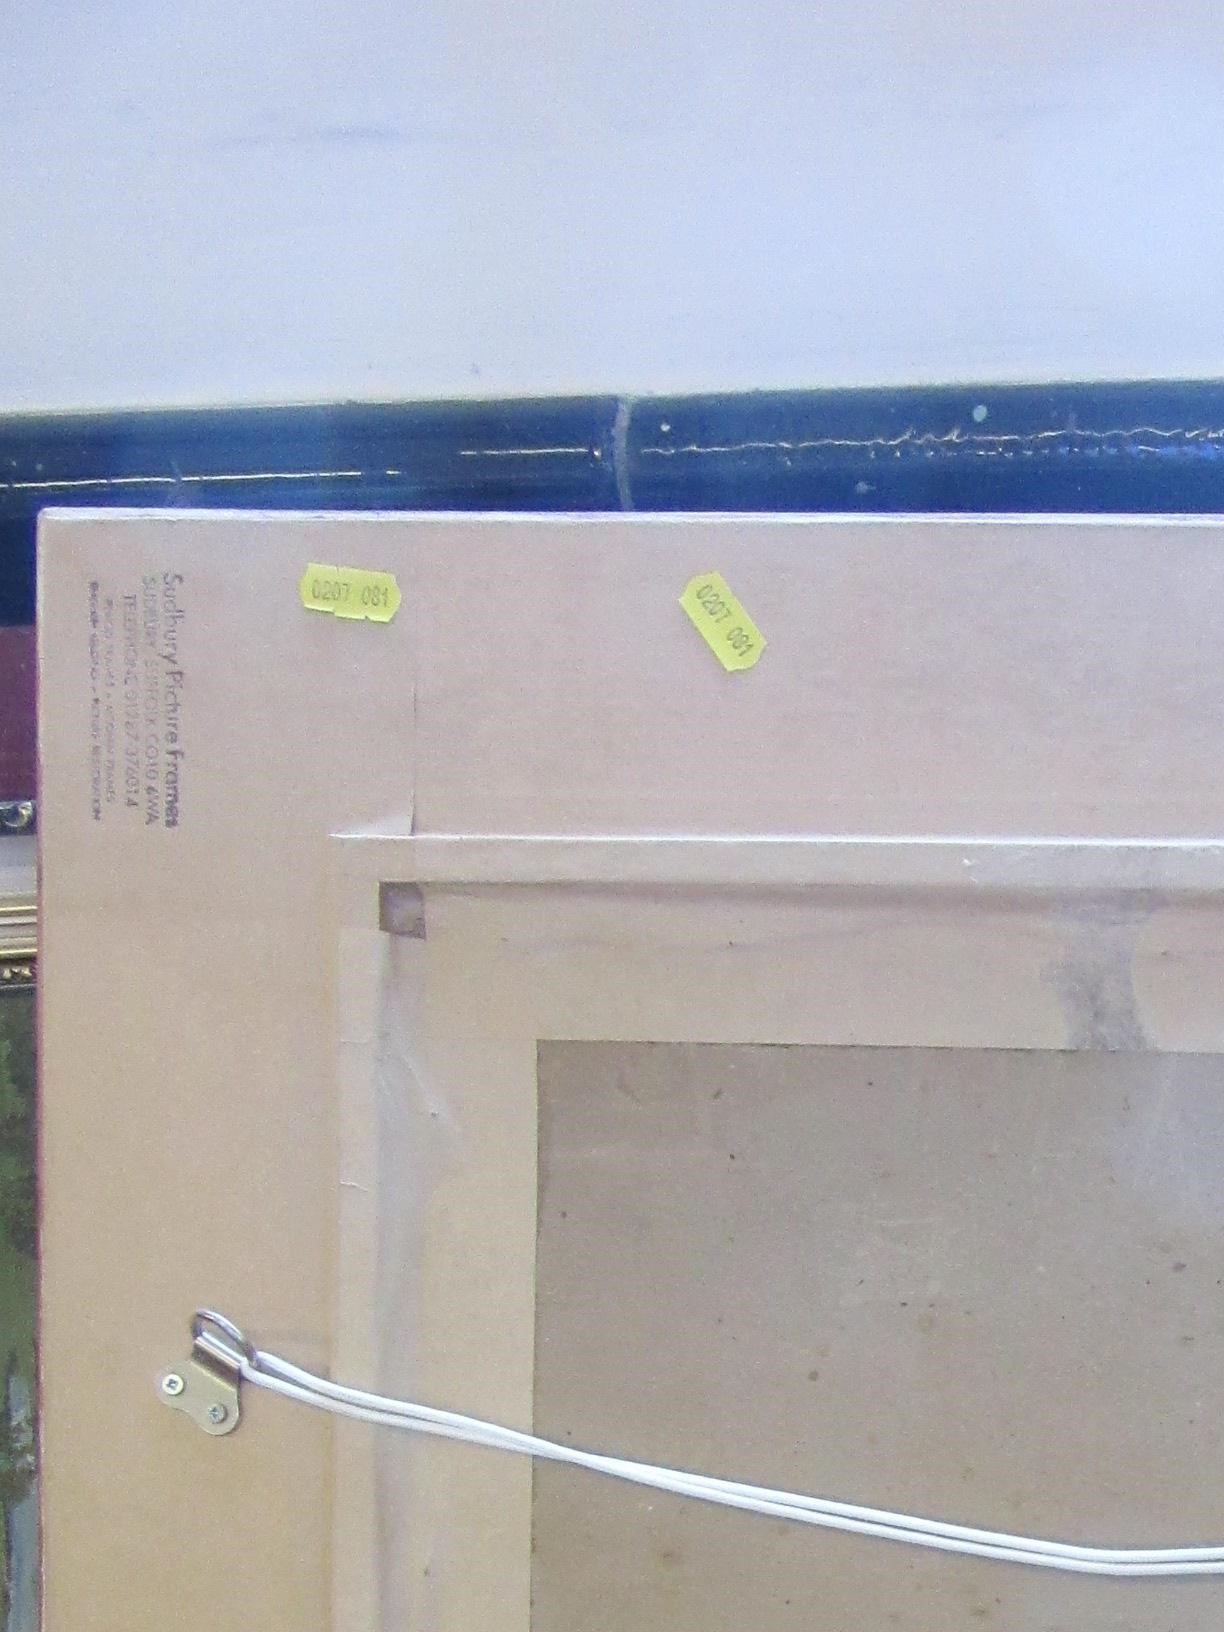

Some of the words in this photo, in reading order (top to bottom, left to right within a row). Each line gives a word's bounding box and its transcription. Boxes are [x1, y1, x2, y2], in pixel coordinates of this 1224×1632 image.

[159, 572, 185, 665] Sudbury
[164, 670, 184, 745] Picture
[165, 750, 185, 829] Frames
